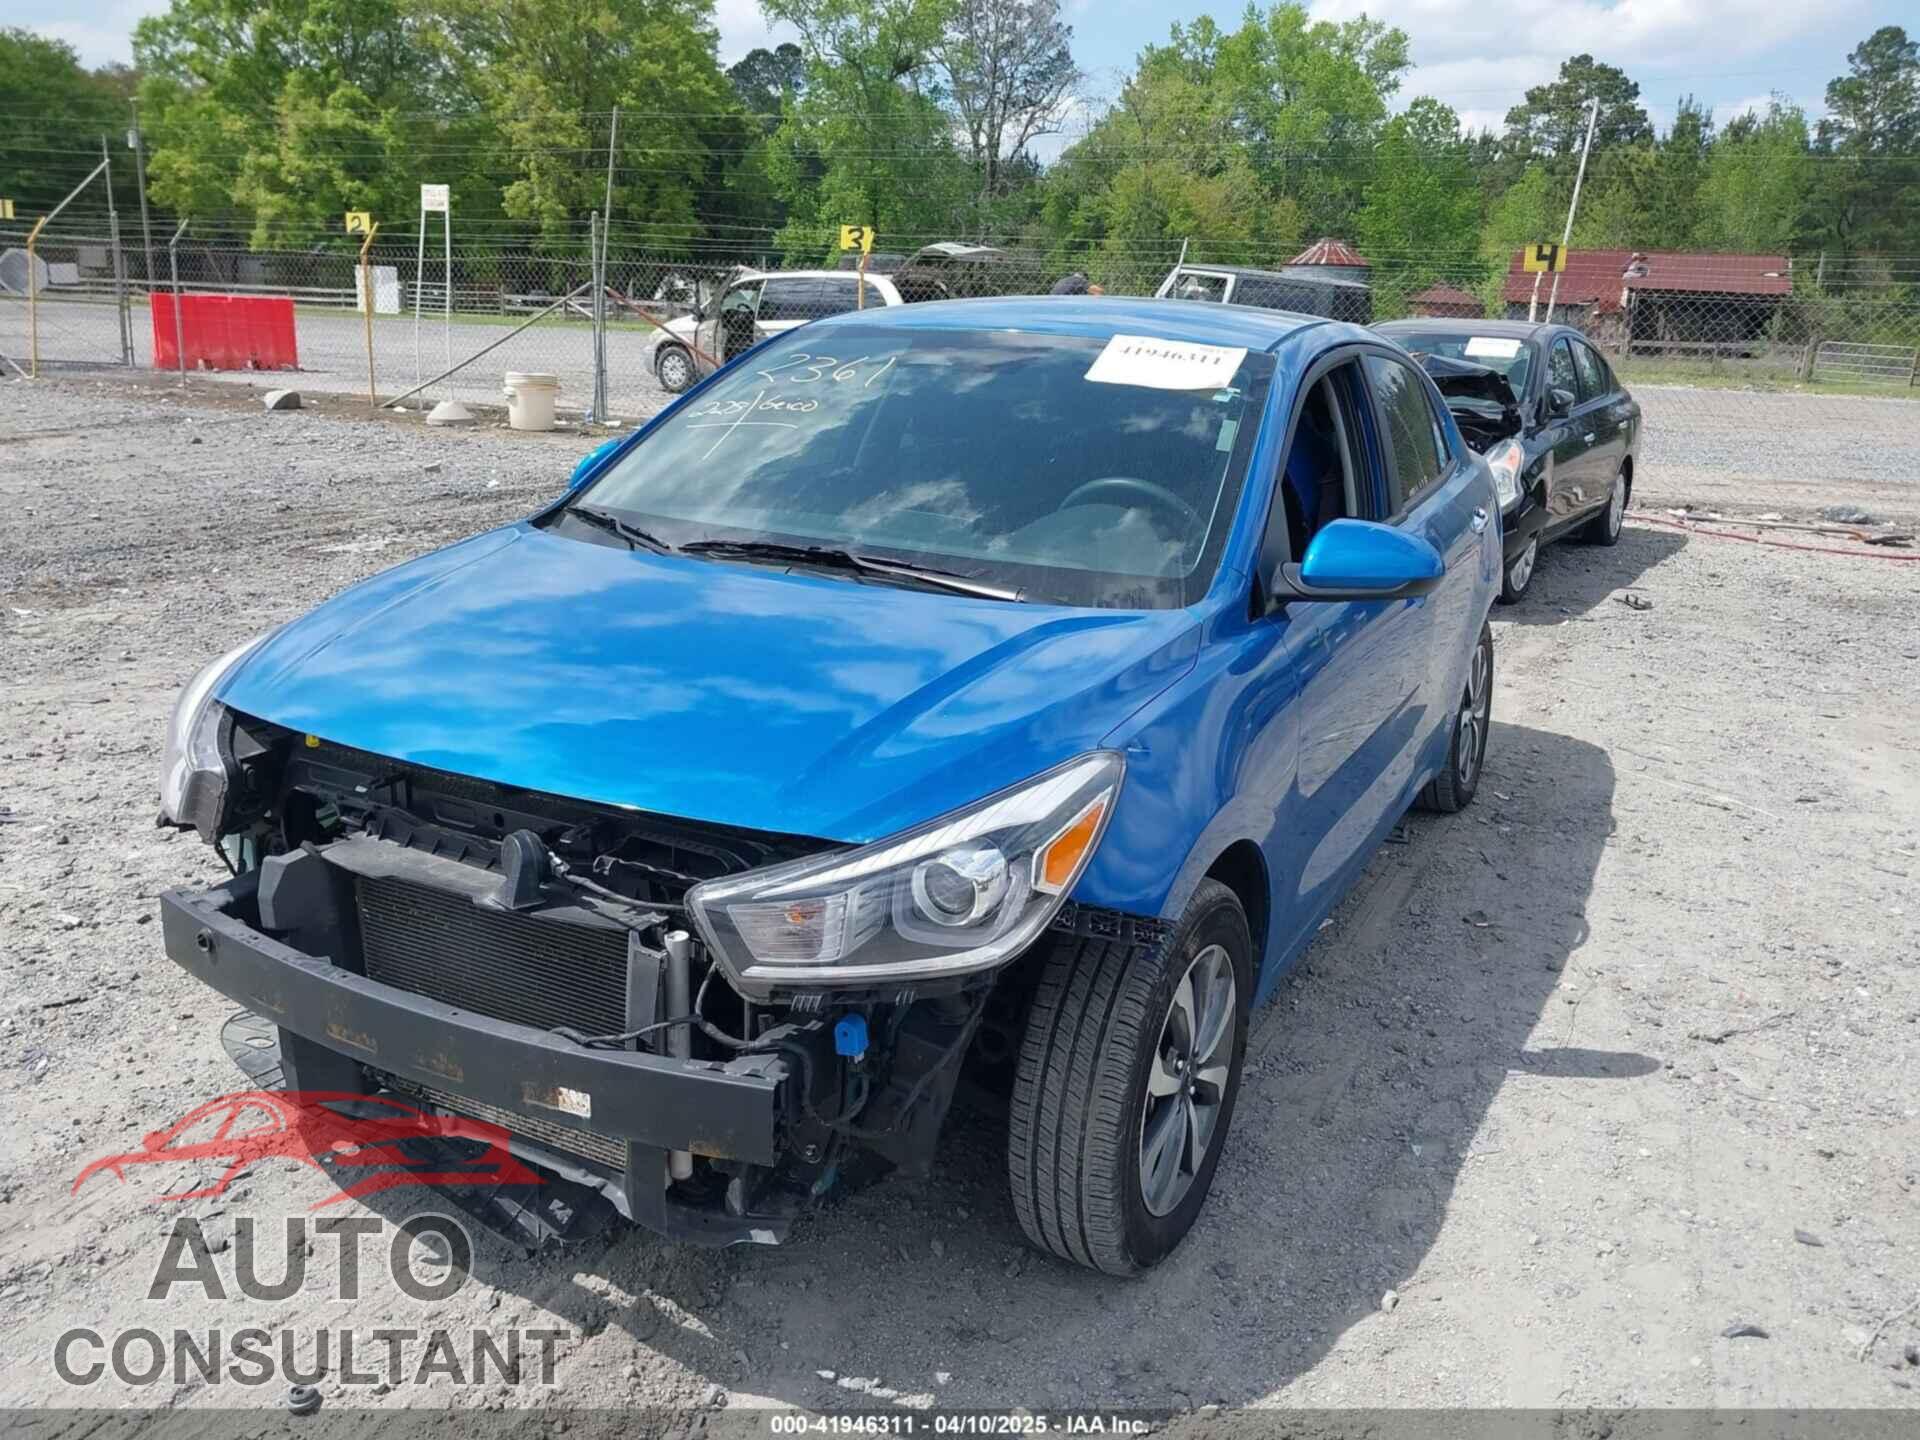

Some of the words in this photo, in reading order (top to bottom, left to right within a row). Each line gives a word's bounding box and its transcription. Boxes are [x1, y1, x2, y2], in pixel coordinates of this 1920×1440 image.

[351, 215, 366, 232] 2
[847, 227, 864, 249] 3
[1535, 244, 1558, 271] 4
[757, 353, 897, 388] 2361
